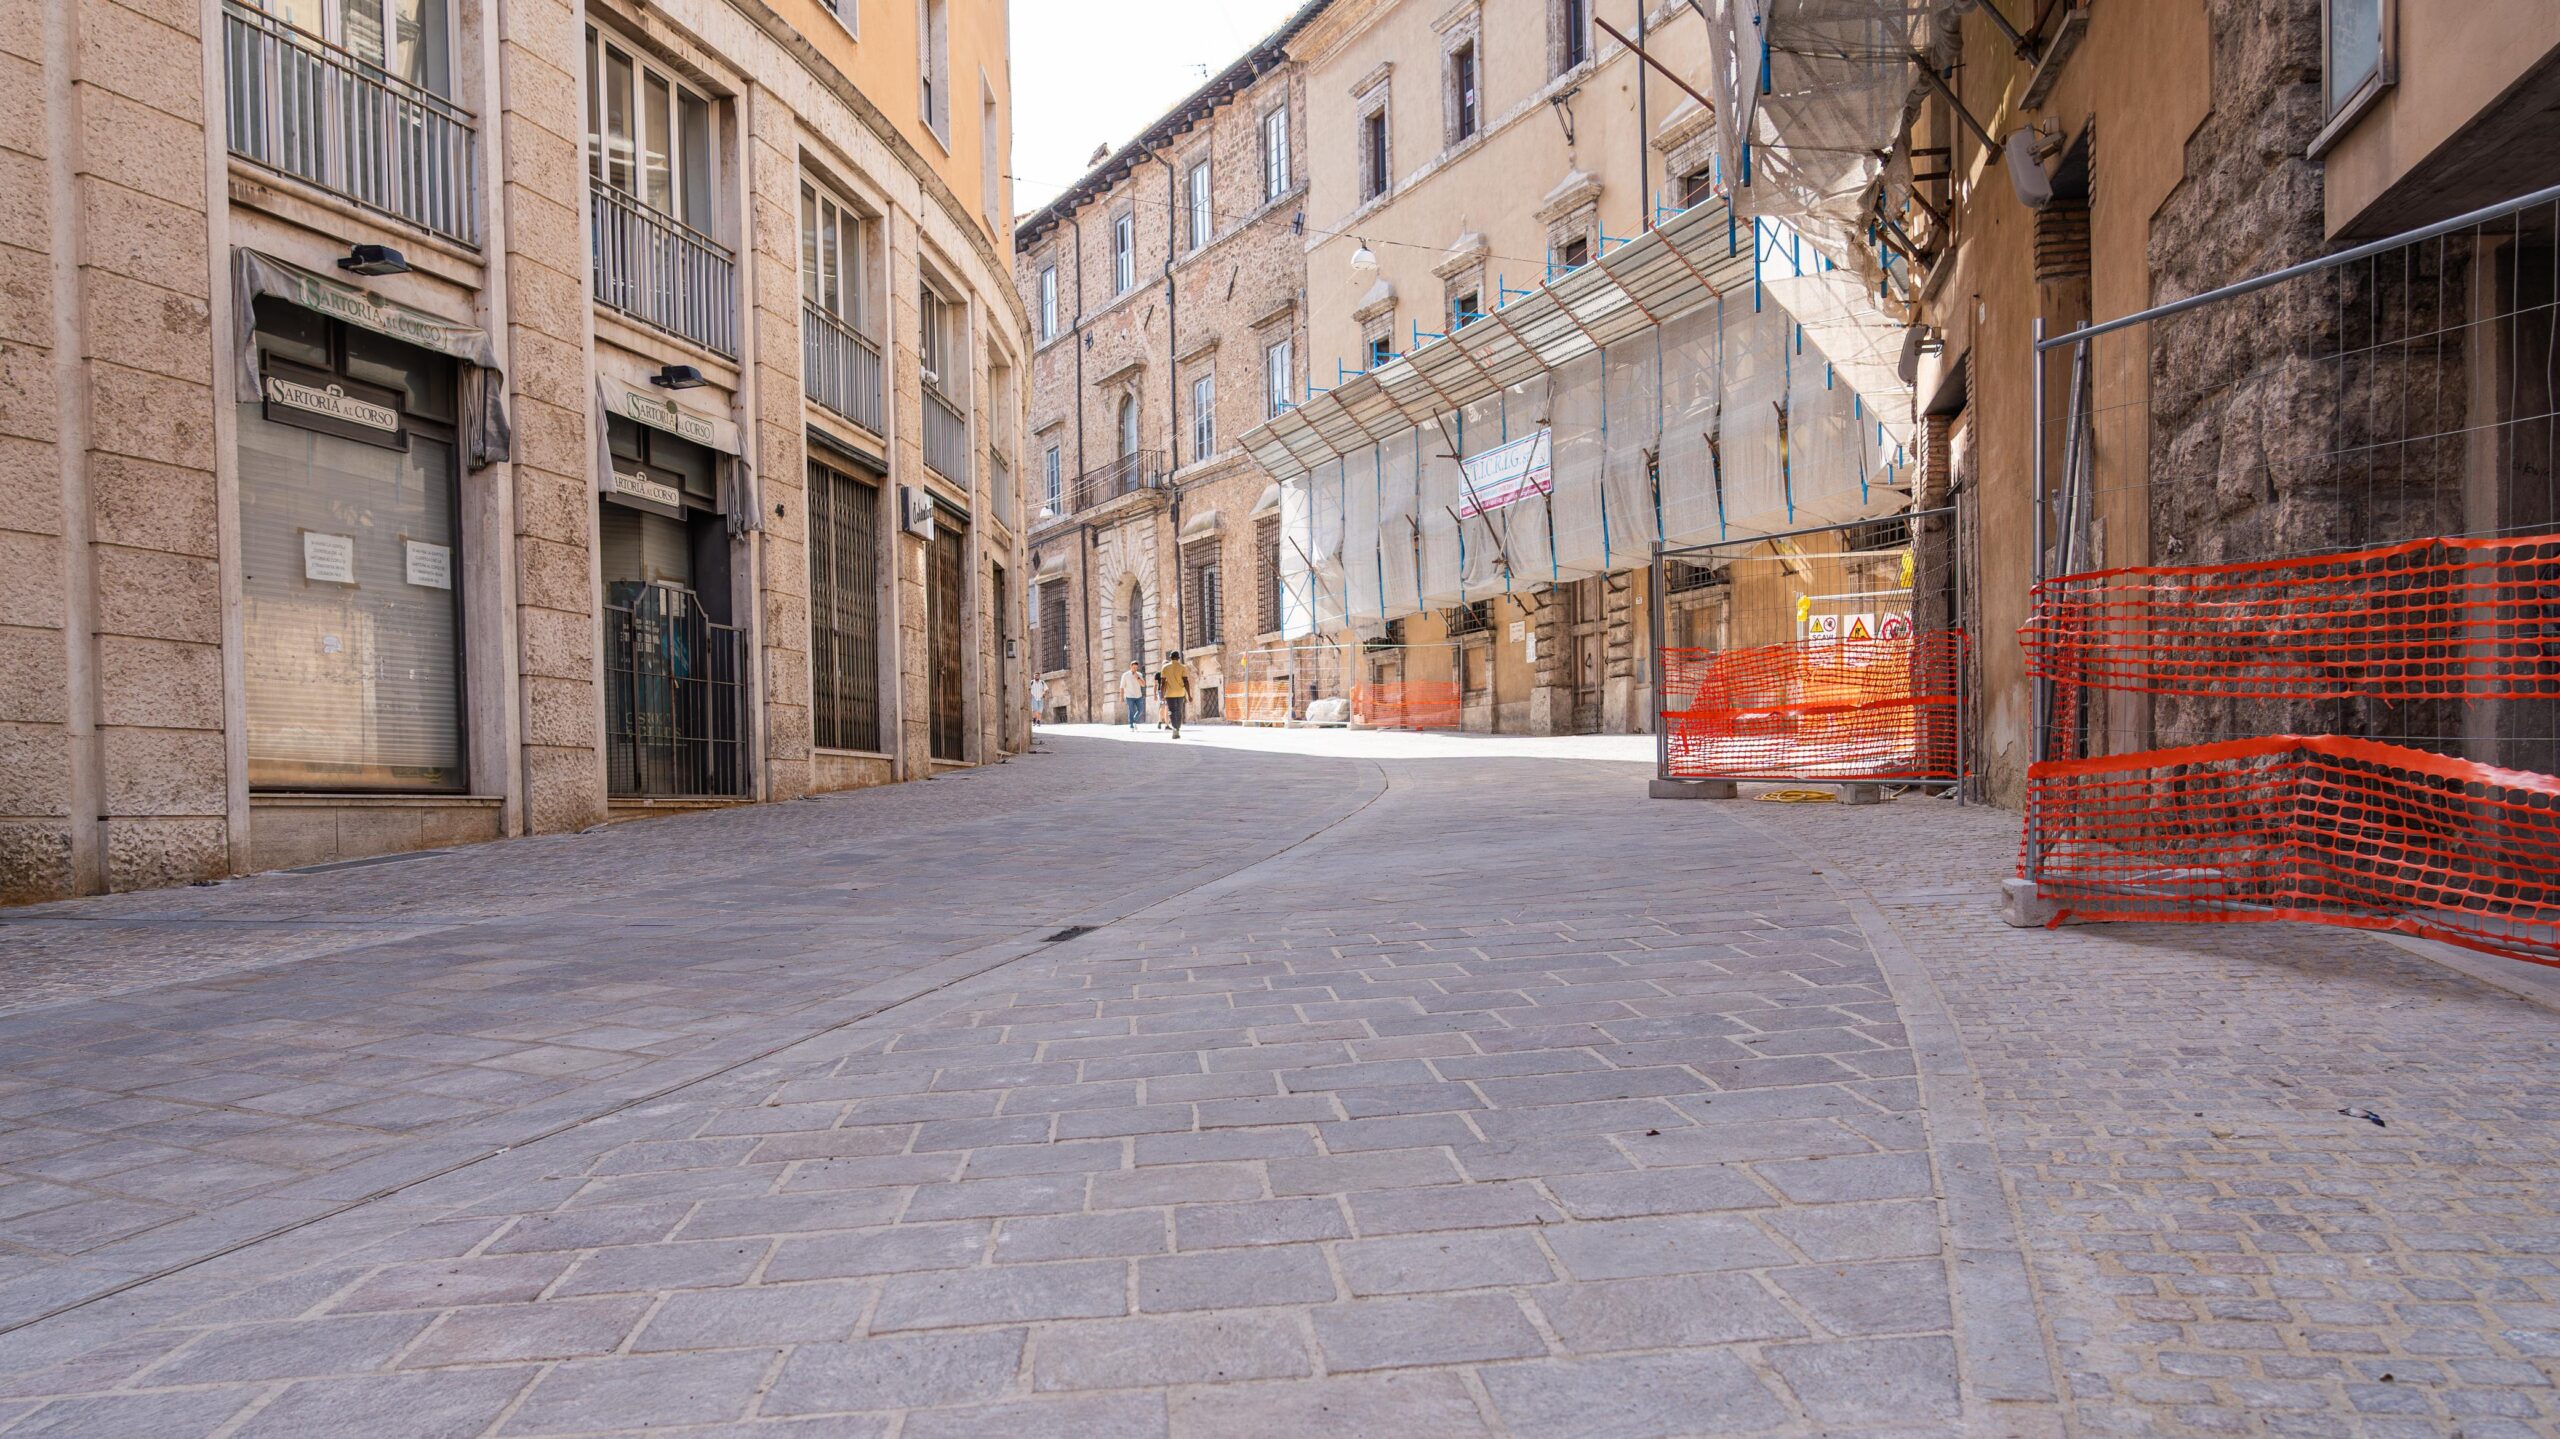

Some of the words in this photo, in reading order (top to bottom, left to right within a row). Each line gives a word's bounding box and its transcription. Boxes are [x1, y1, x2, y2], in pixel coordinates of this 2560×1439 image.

[302, 278, 383, 324] SARTORIA
[398, 316, 441, 342] CORSO
[271, 378, 341, 413] SARTORIA
[342, 406, 354, 417] AL
[354, 405, 394, 427] CORSO
[631, 395, 676, 426] SARTORIA
[685, 420, 711, 439] CORSO
[614, 476, 646, 495] ARTORIA
[653, 487, 677, 502] CORSO
